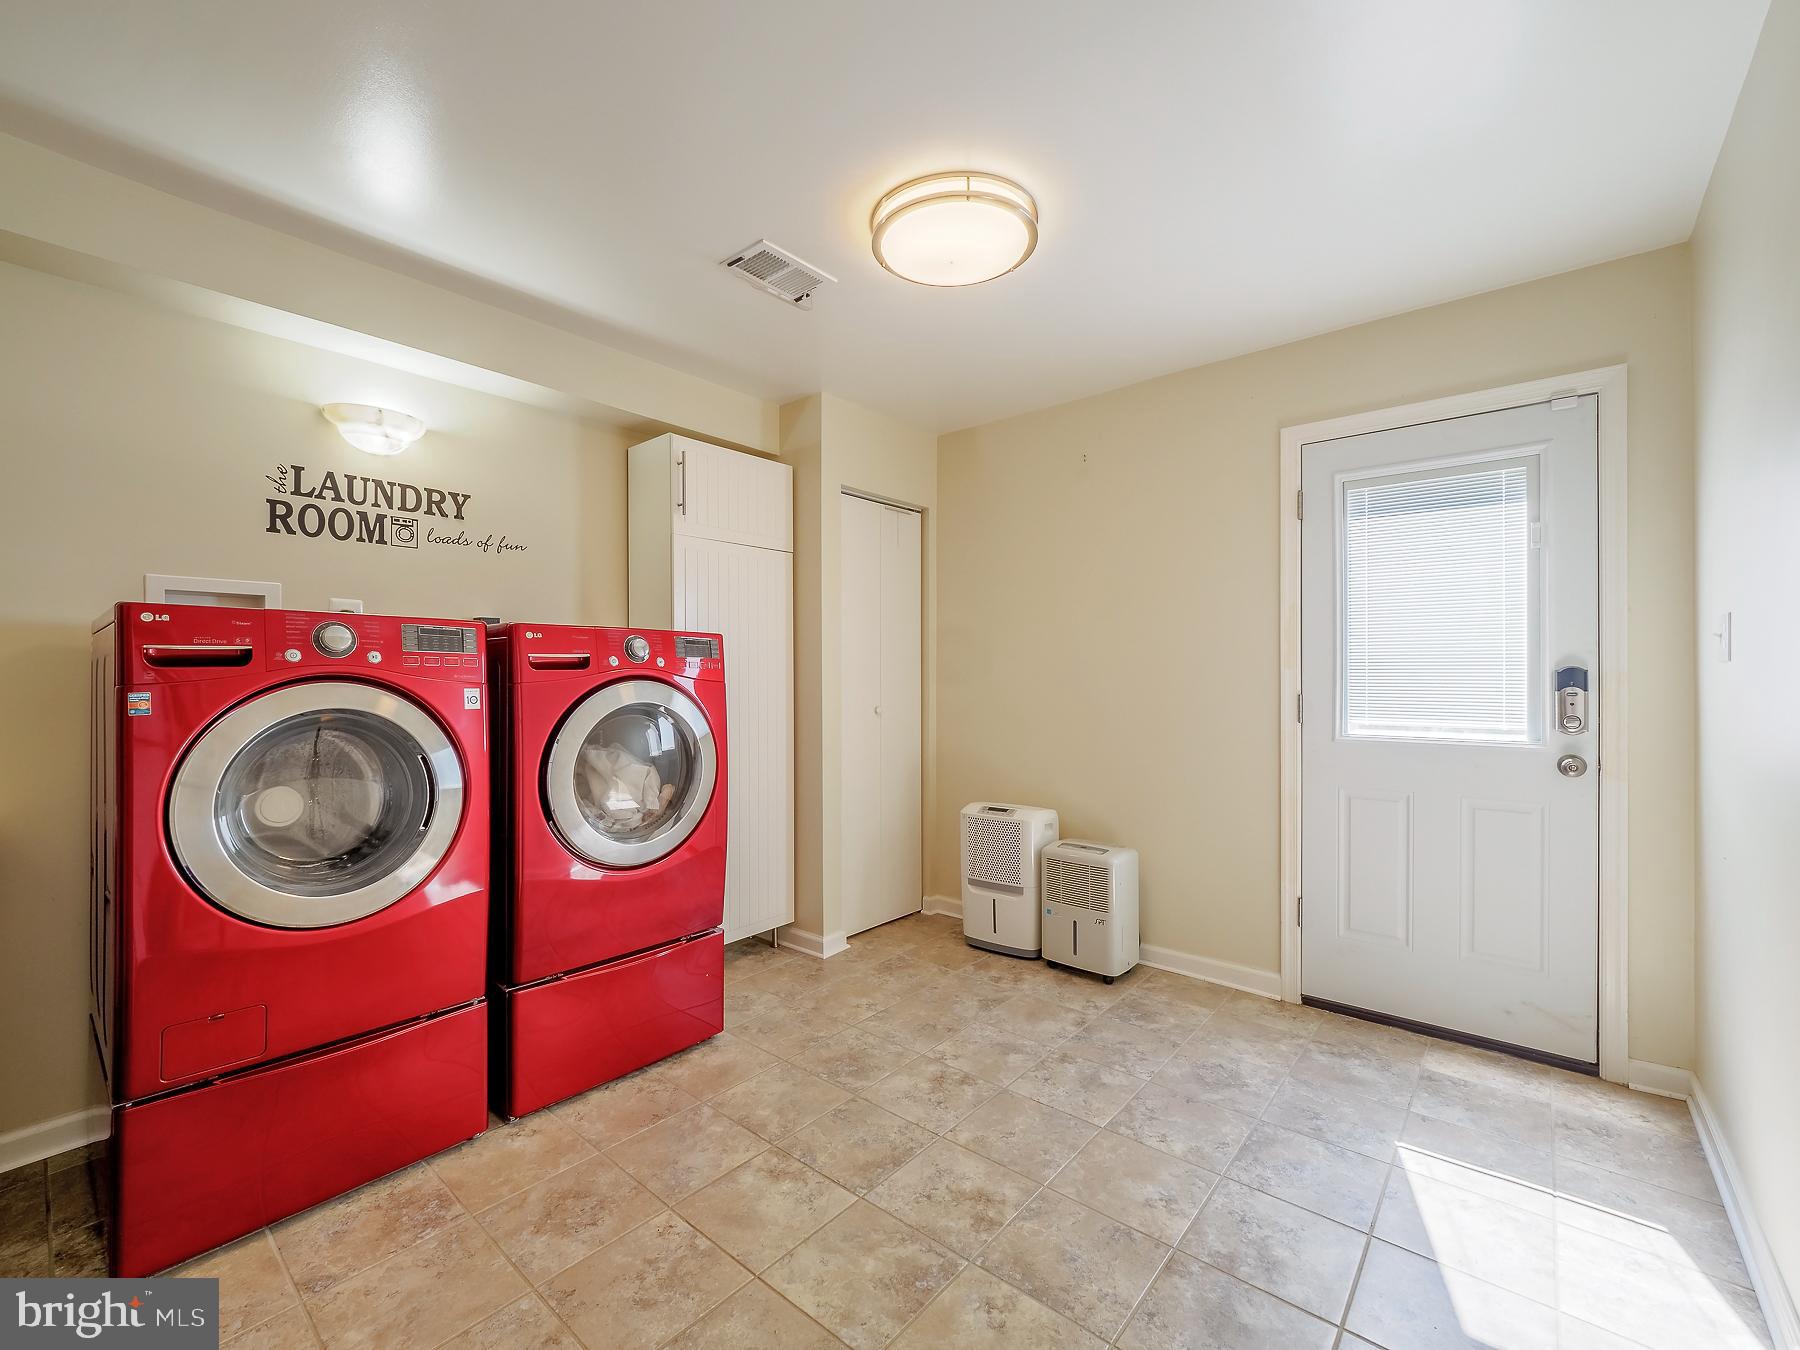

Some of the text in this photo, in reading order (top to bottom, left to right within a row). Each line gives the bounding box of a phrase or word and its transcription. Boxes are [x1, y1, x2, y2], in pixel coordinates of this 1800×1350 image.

[265, 463, 471, 521] the LAUNDRY
[265, 498, 388, 546] ROOM
[426, 527, 528, 554] loads of fun
